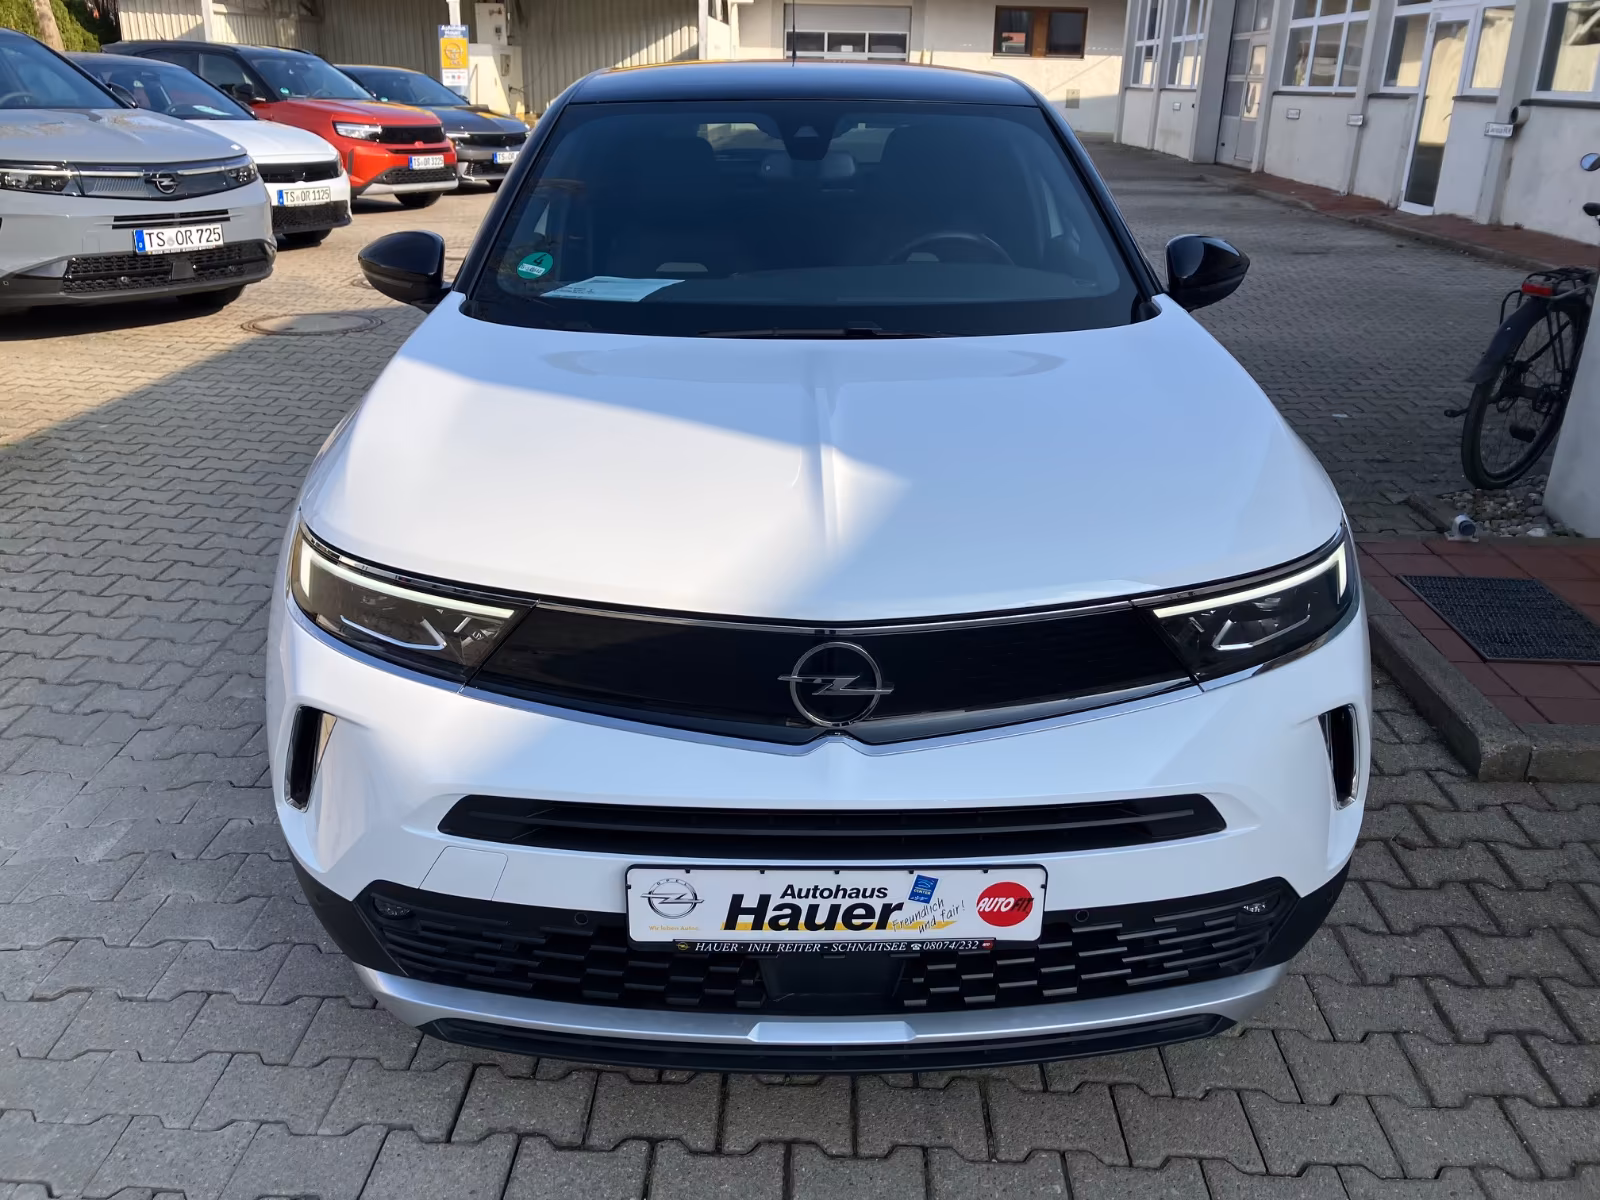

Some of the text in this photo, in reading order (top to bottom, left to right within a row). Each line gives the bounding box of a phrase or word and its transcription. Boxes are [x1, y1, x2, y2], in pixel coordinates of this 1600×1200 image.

[284, 189, 330, 203] TS OR 1125
[145, 227, 221, 248] TS OR 725
[533, 253, 547, 266] 4
[779, 884, 889, 900] Autohaus
[723, 894, 904, 931] Hauer
[892, 897, 945, 933] Freundlich
[918, 915, 937, 934] und
[695, 942, 739, 952] HAUER
[747, 943, 773, 953] INH.
[776, 943, 821, 953] REITER
[831, 942, 908, 953] SCHNAITSEE
[922, 940, 979, 951] 08074/232
